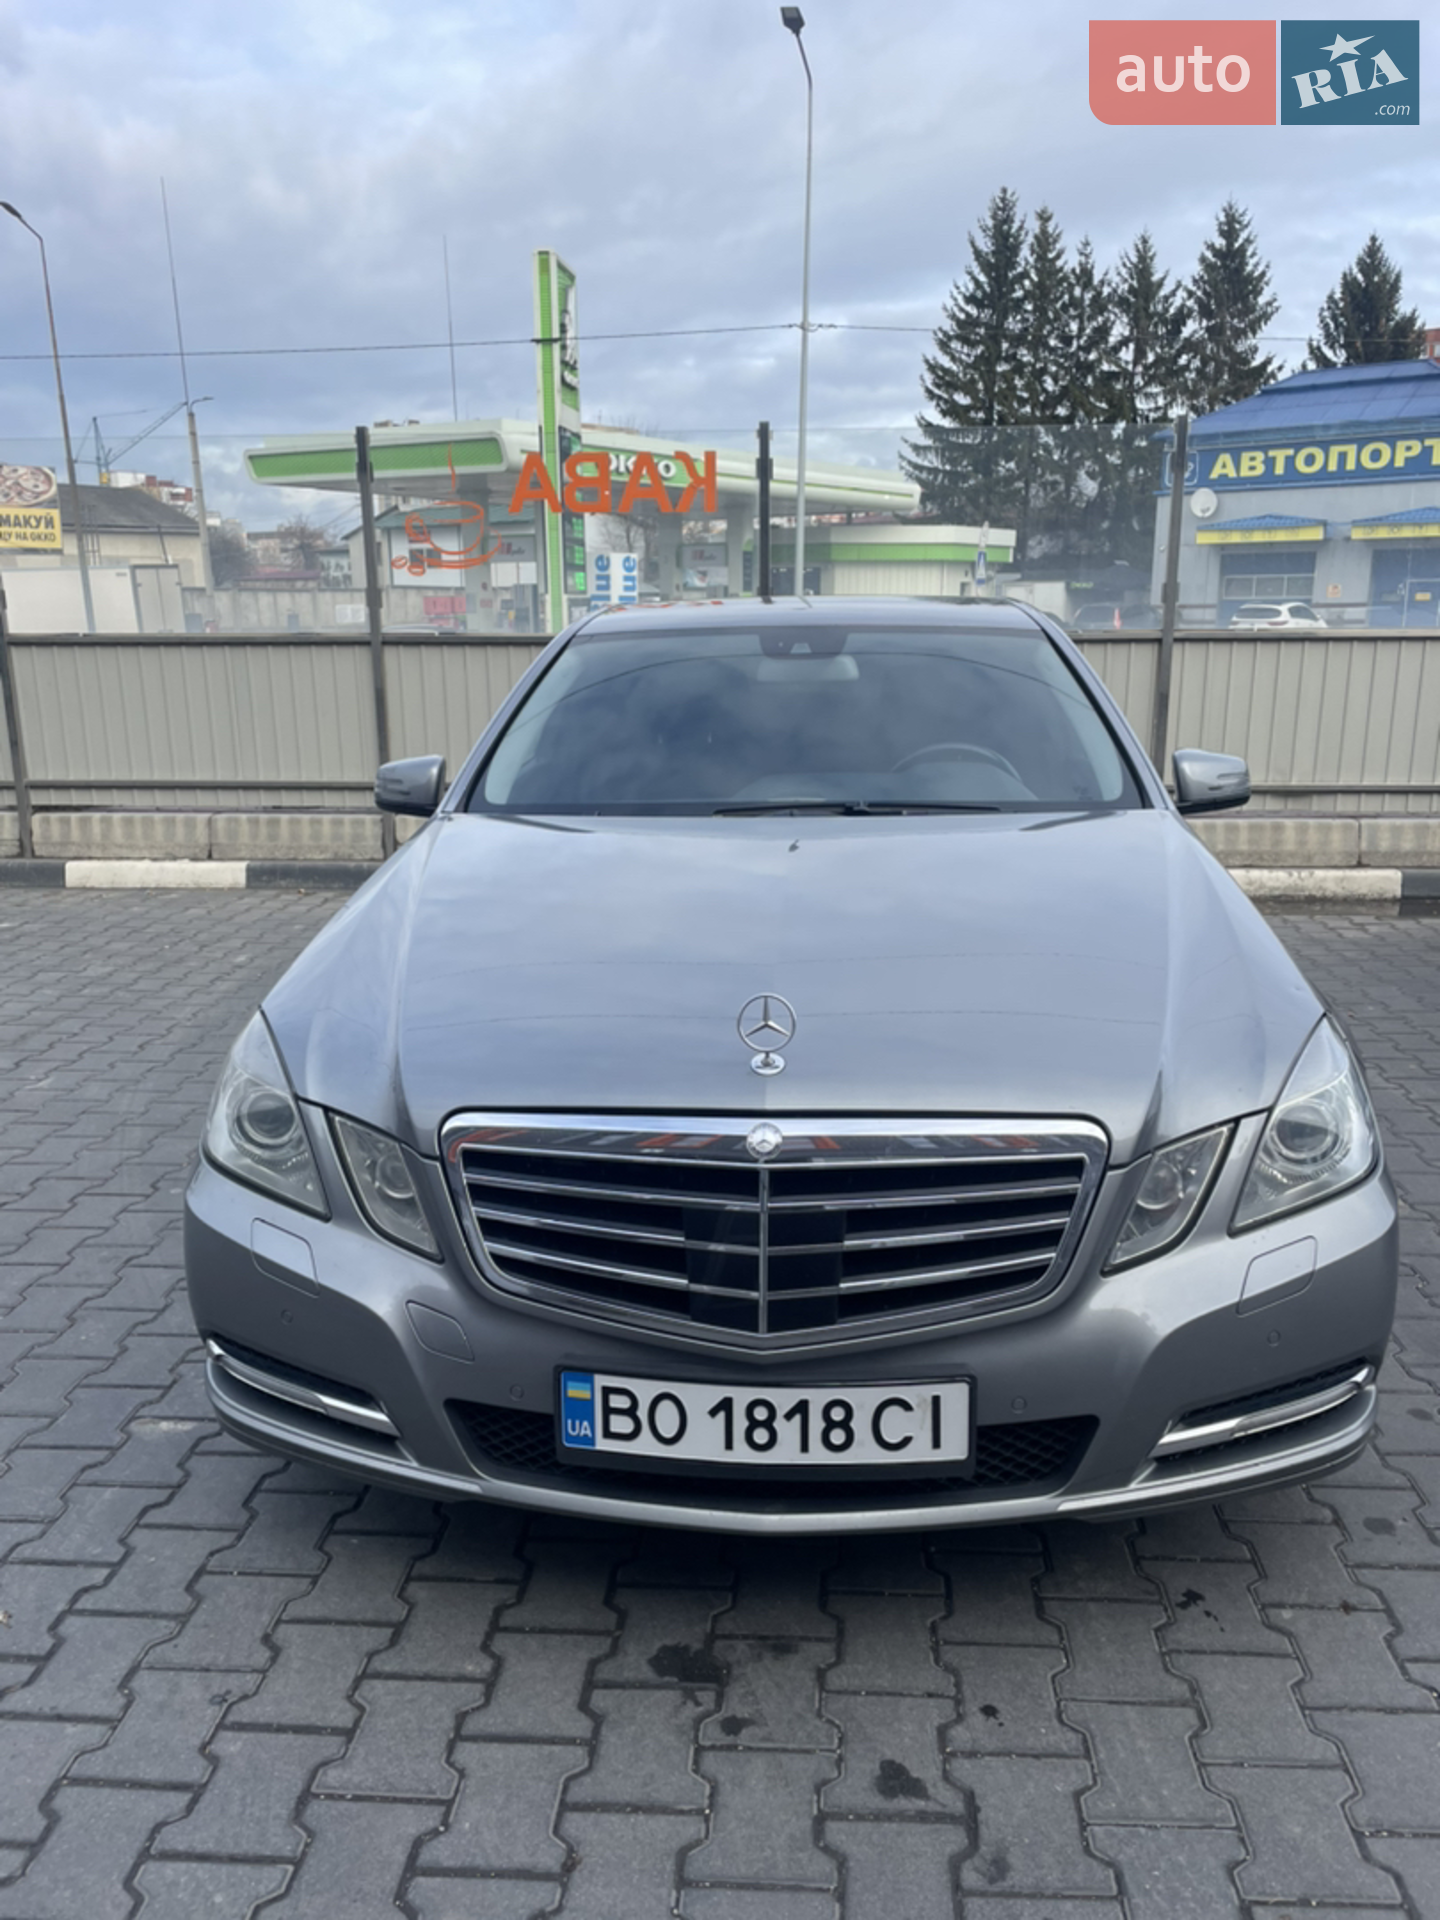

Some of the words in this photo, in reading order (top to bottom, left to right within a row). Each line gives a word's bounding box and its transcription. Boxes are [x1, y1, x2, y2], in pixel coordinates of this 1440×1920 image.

[1209, 438, 1440, 479] АВТОПОРТ
[591, 554, 611, 609] lue
[567, 1419, 592, 1438] UA
[601, 1386, 688, 1446] BO
[707, 1396, 855, 1454] 1818
[871, 1395, 941, 1451] CI
